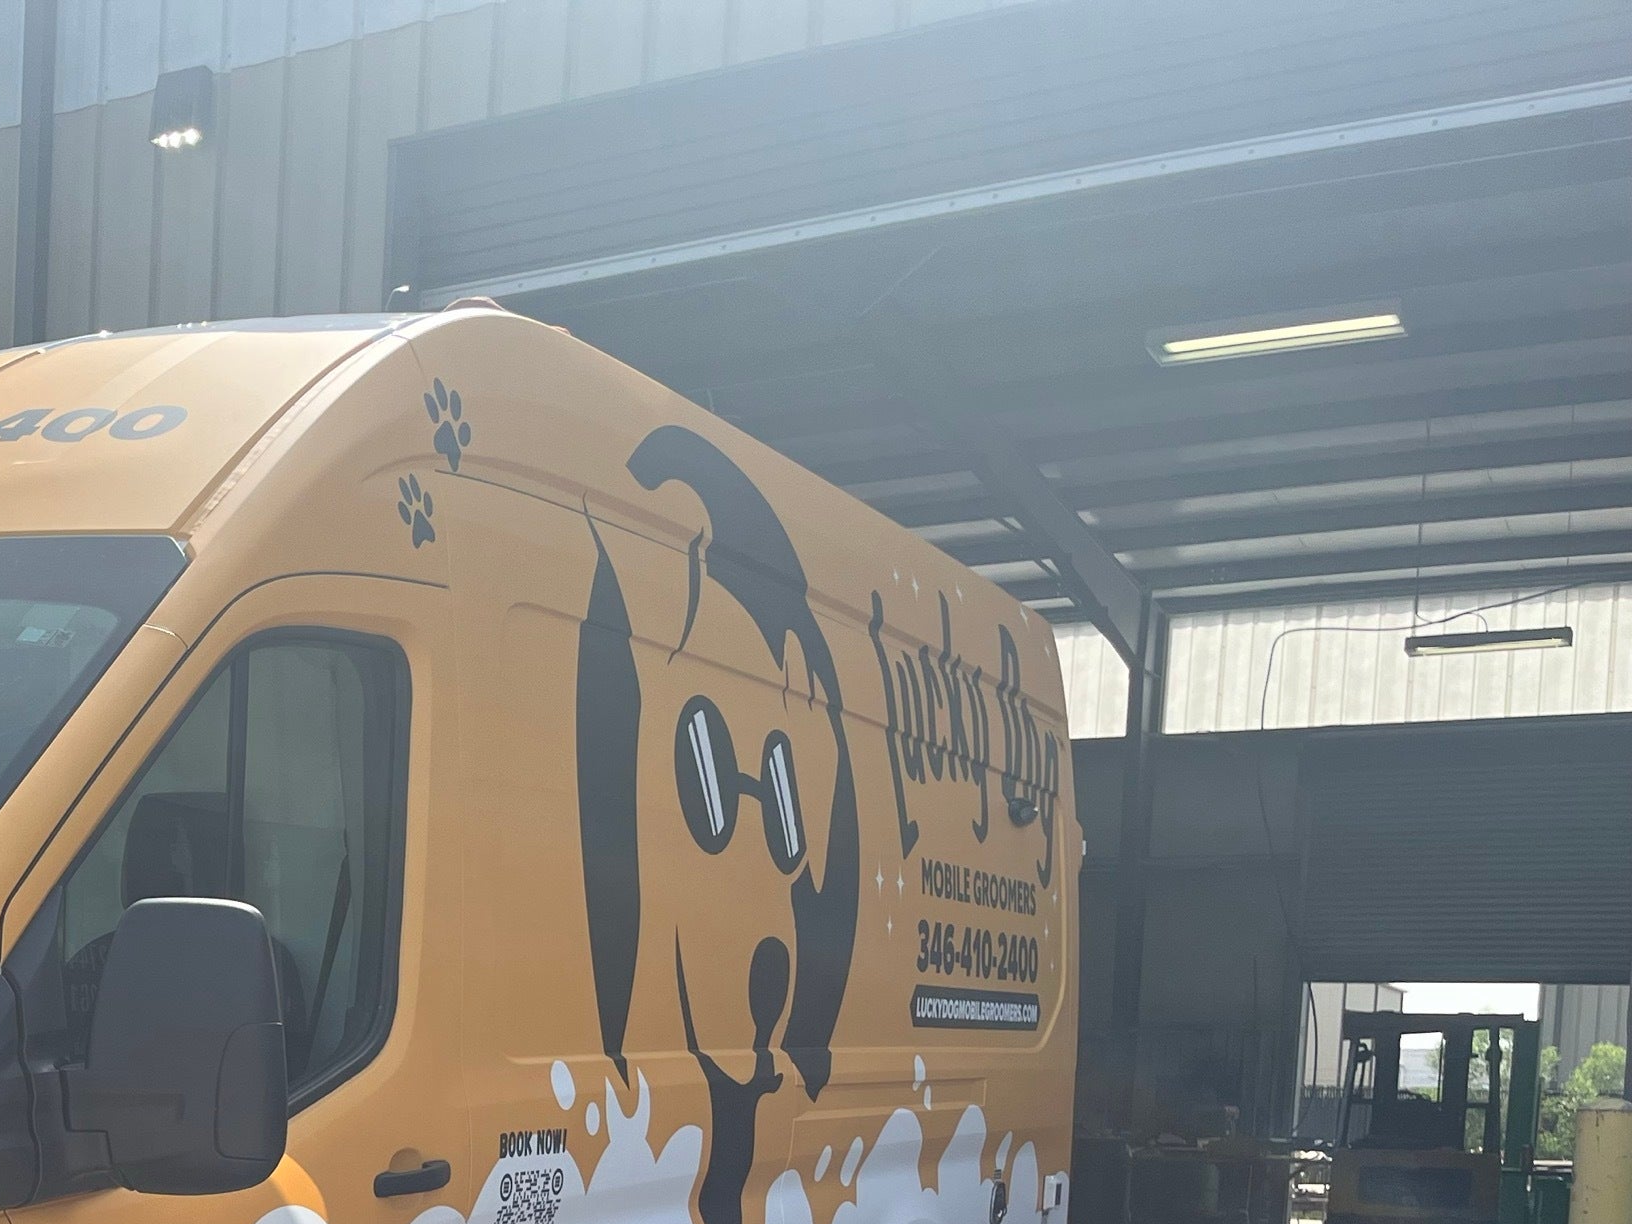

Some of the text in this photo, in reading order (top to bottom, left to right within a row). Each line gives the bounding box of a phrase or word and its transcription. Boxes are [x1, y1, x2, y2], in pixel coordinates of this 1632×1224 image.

[869, 589, 1059, 889] Lucky Dog
[921, 857, 1037, 917] MOBILE GROOMERS
[916, 919, 1039, 984] 346-410-2400
[915, 997, 1038, 1023] LUCKYDOGMOBILEGROOMERS.COM
[499, 1128, 568, 1159] BOOK NOW!
